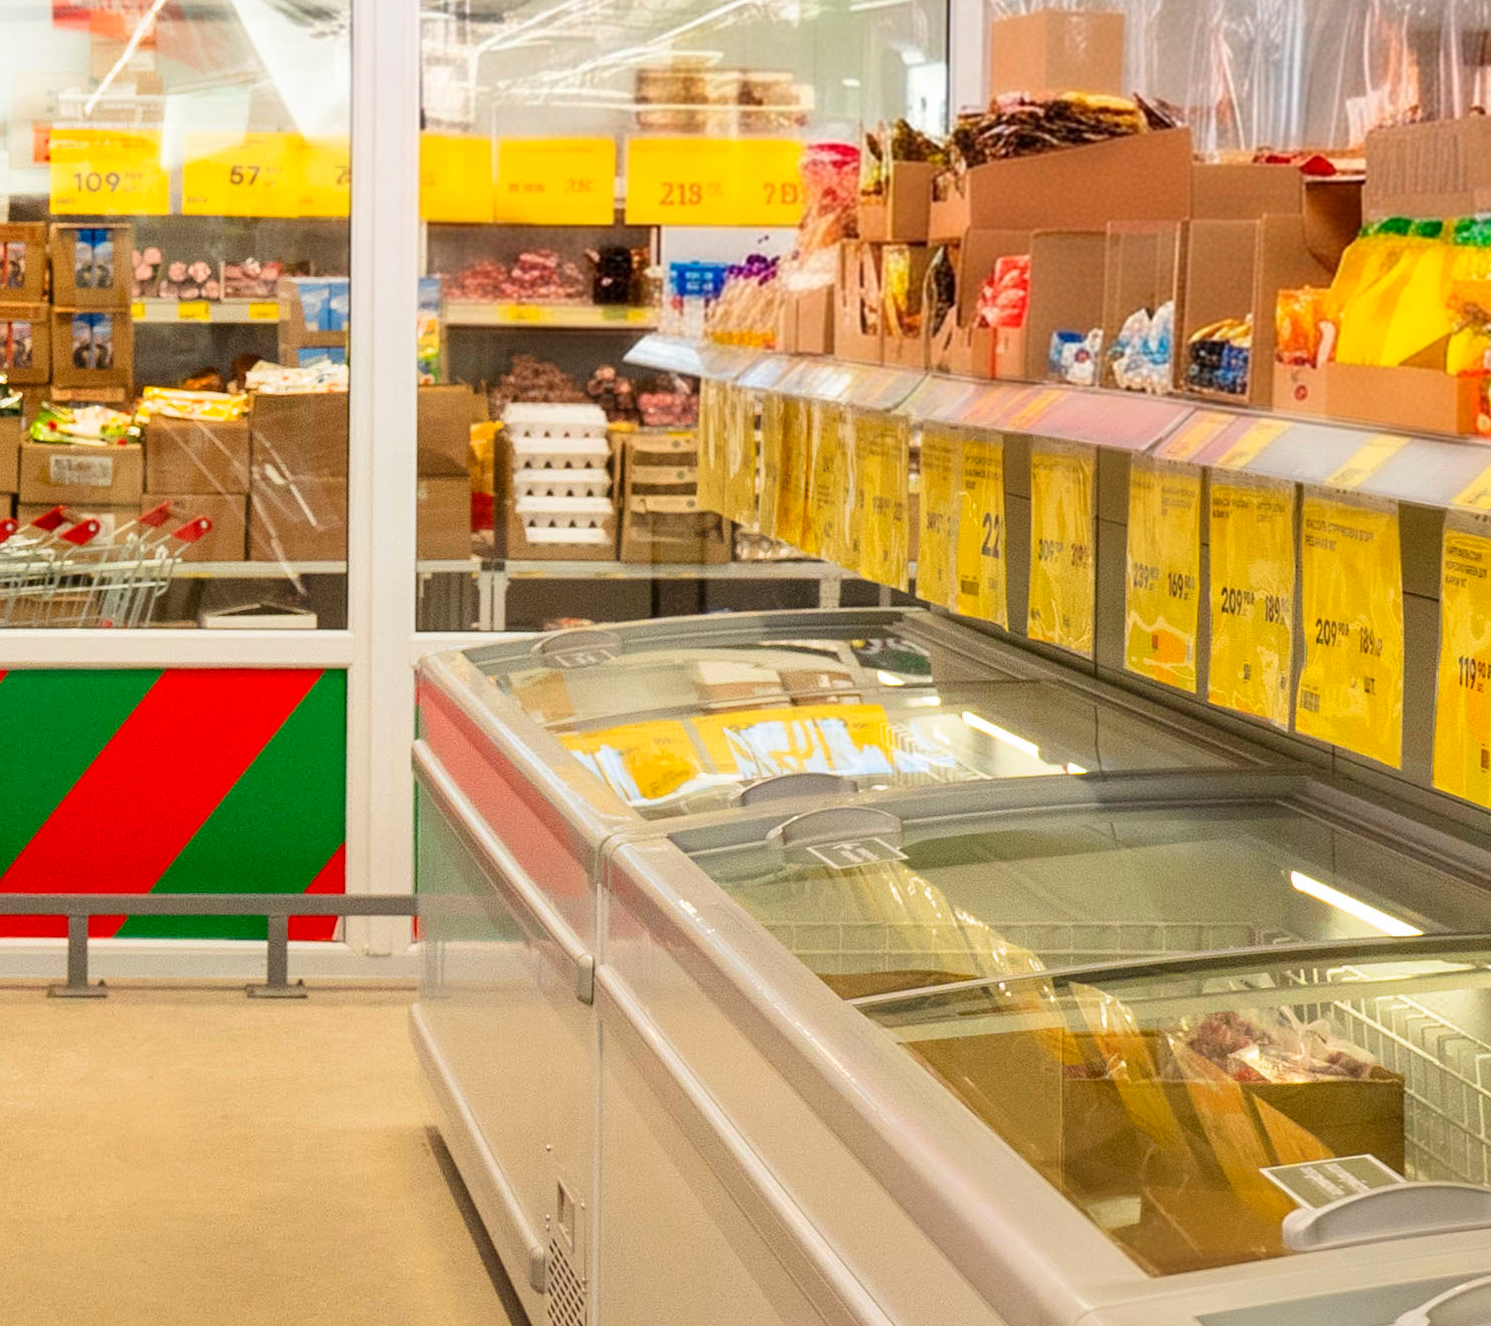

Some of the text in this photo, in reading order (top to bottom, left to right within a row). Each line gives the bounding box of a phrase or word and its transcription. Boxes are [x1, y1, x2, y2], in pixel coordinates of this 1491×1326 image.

[73, 171, 121, 194] 109
[1168, 571, 1183, 600] 169
[1221, 586, 1243, 615] 209
[1315, 618, 1337, 647] 209
[1458, 655, 1476, 690] 119
